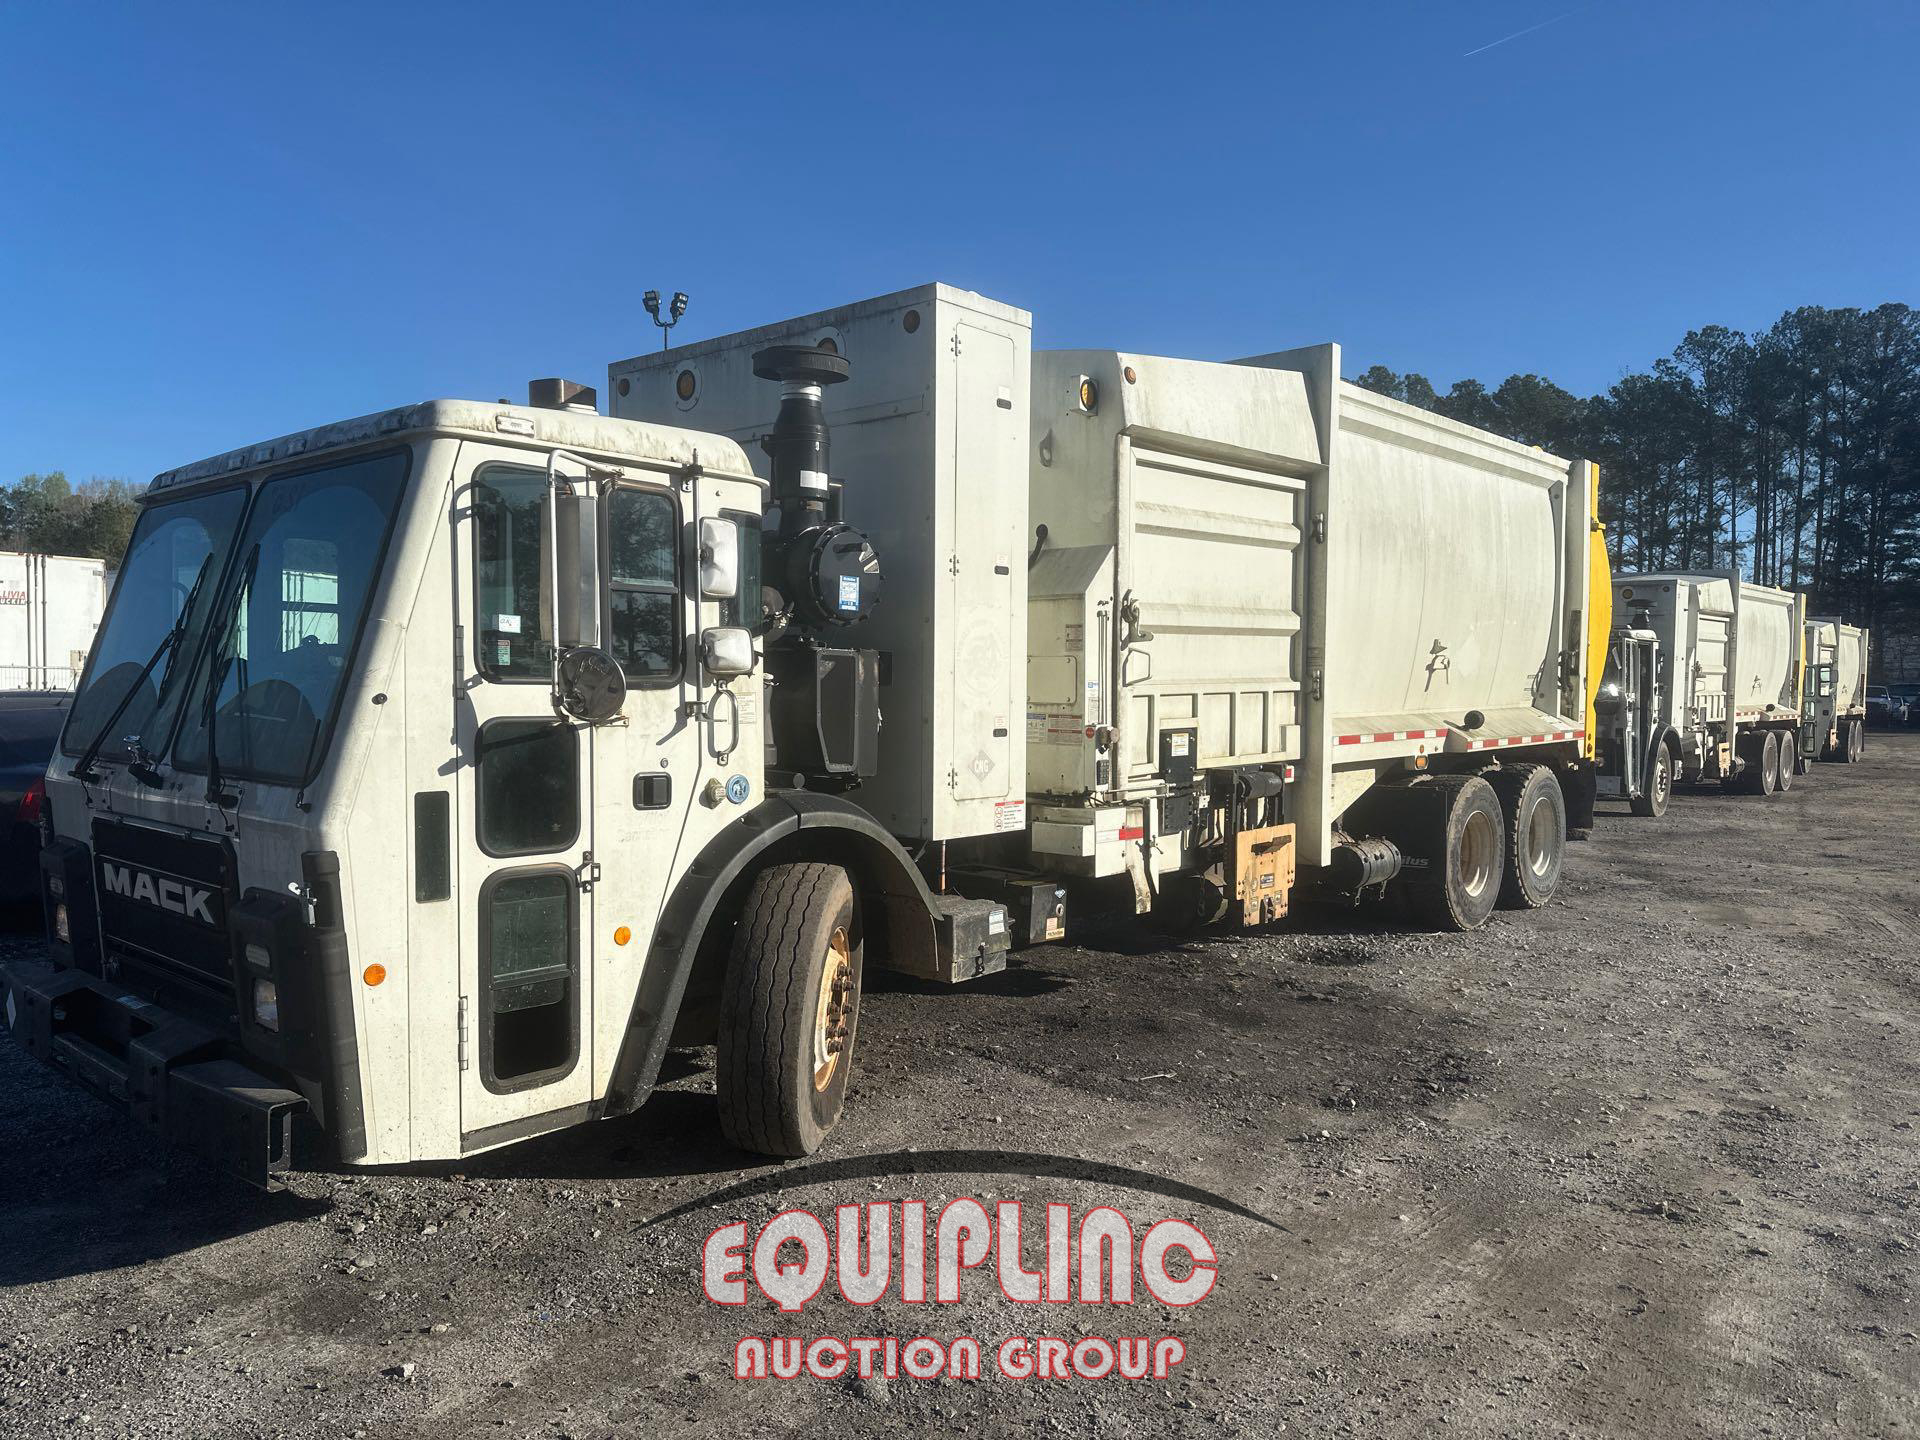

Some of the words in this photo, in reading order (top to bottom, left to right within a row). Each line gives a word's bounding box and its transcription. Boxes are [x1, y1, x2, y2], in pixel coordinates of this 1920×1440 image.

[0, 590, 26, 599] LIVIA
[974, 759, 989, 773] CNG
[103, 862, 215, 924] MACK
